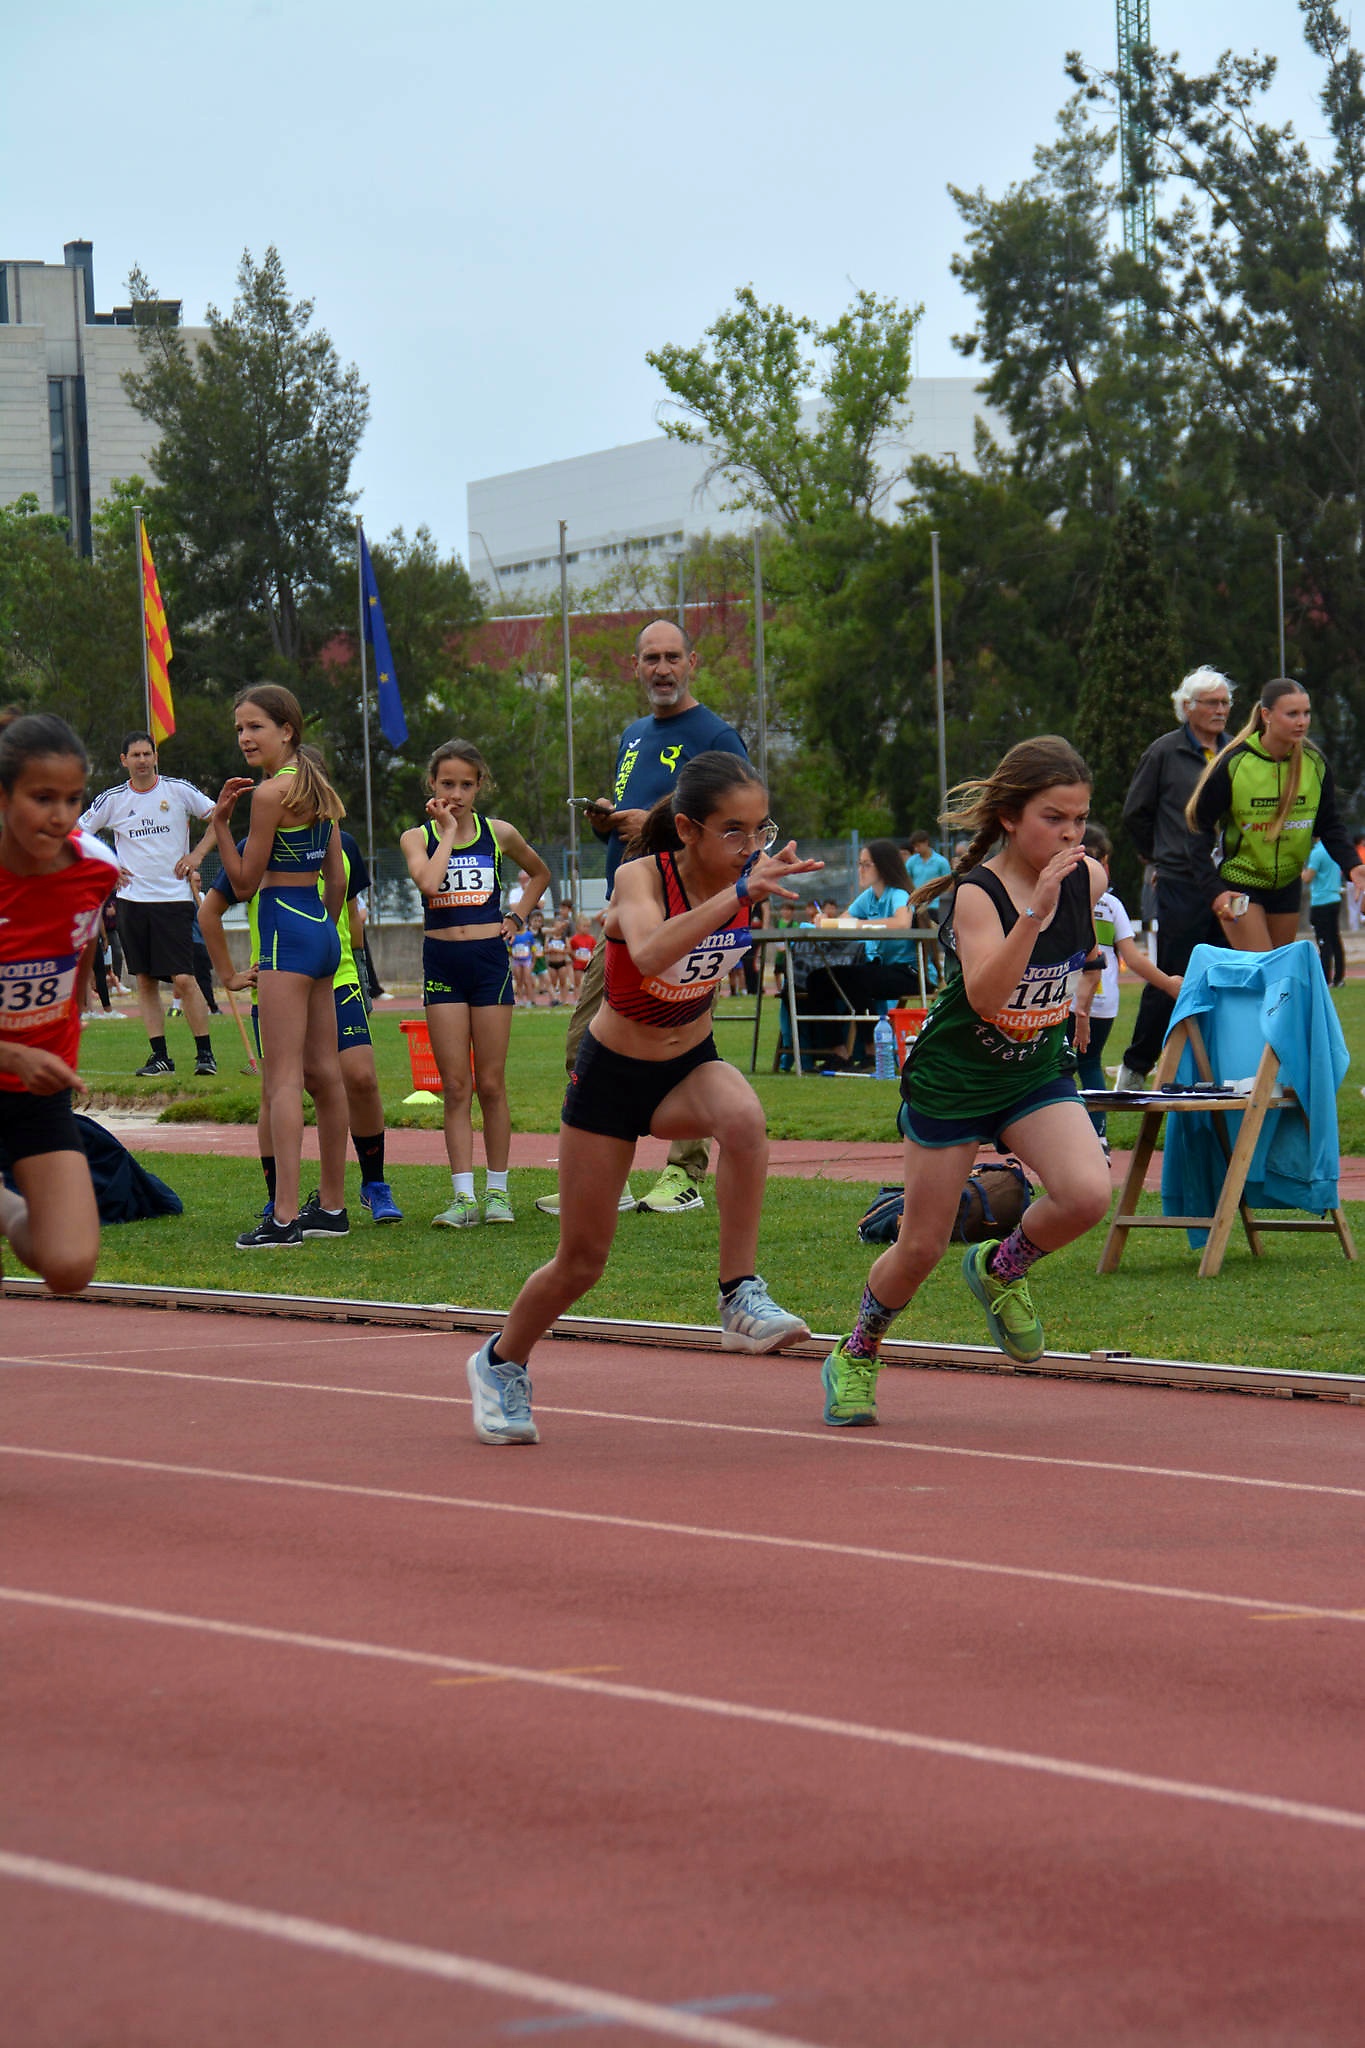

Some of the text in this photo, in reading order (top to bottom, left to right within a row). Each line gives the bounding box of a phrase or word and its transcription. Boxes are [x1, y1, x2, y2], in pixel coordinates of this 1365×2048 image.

[128, 824, 170, 838] Emirates
[141, 818, 154, 827] Fly
[680, 952, 724, 984] 53
[0, 977, 59, 1010] 38
[1007, 976, 1067, 1010] 144
